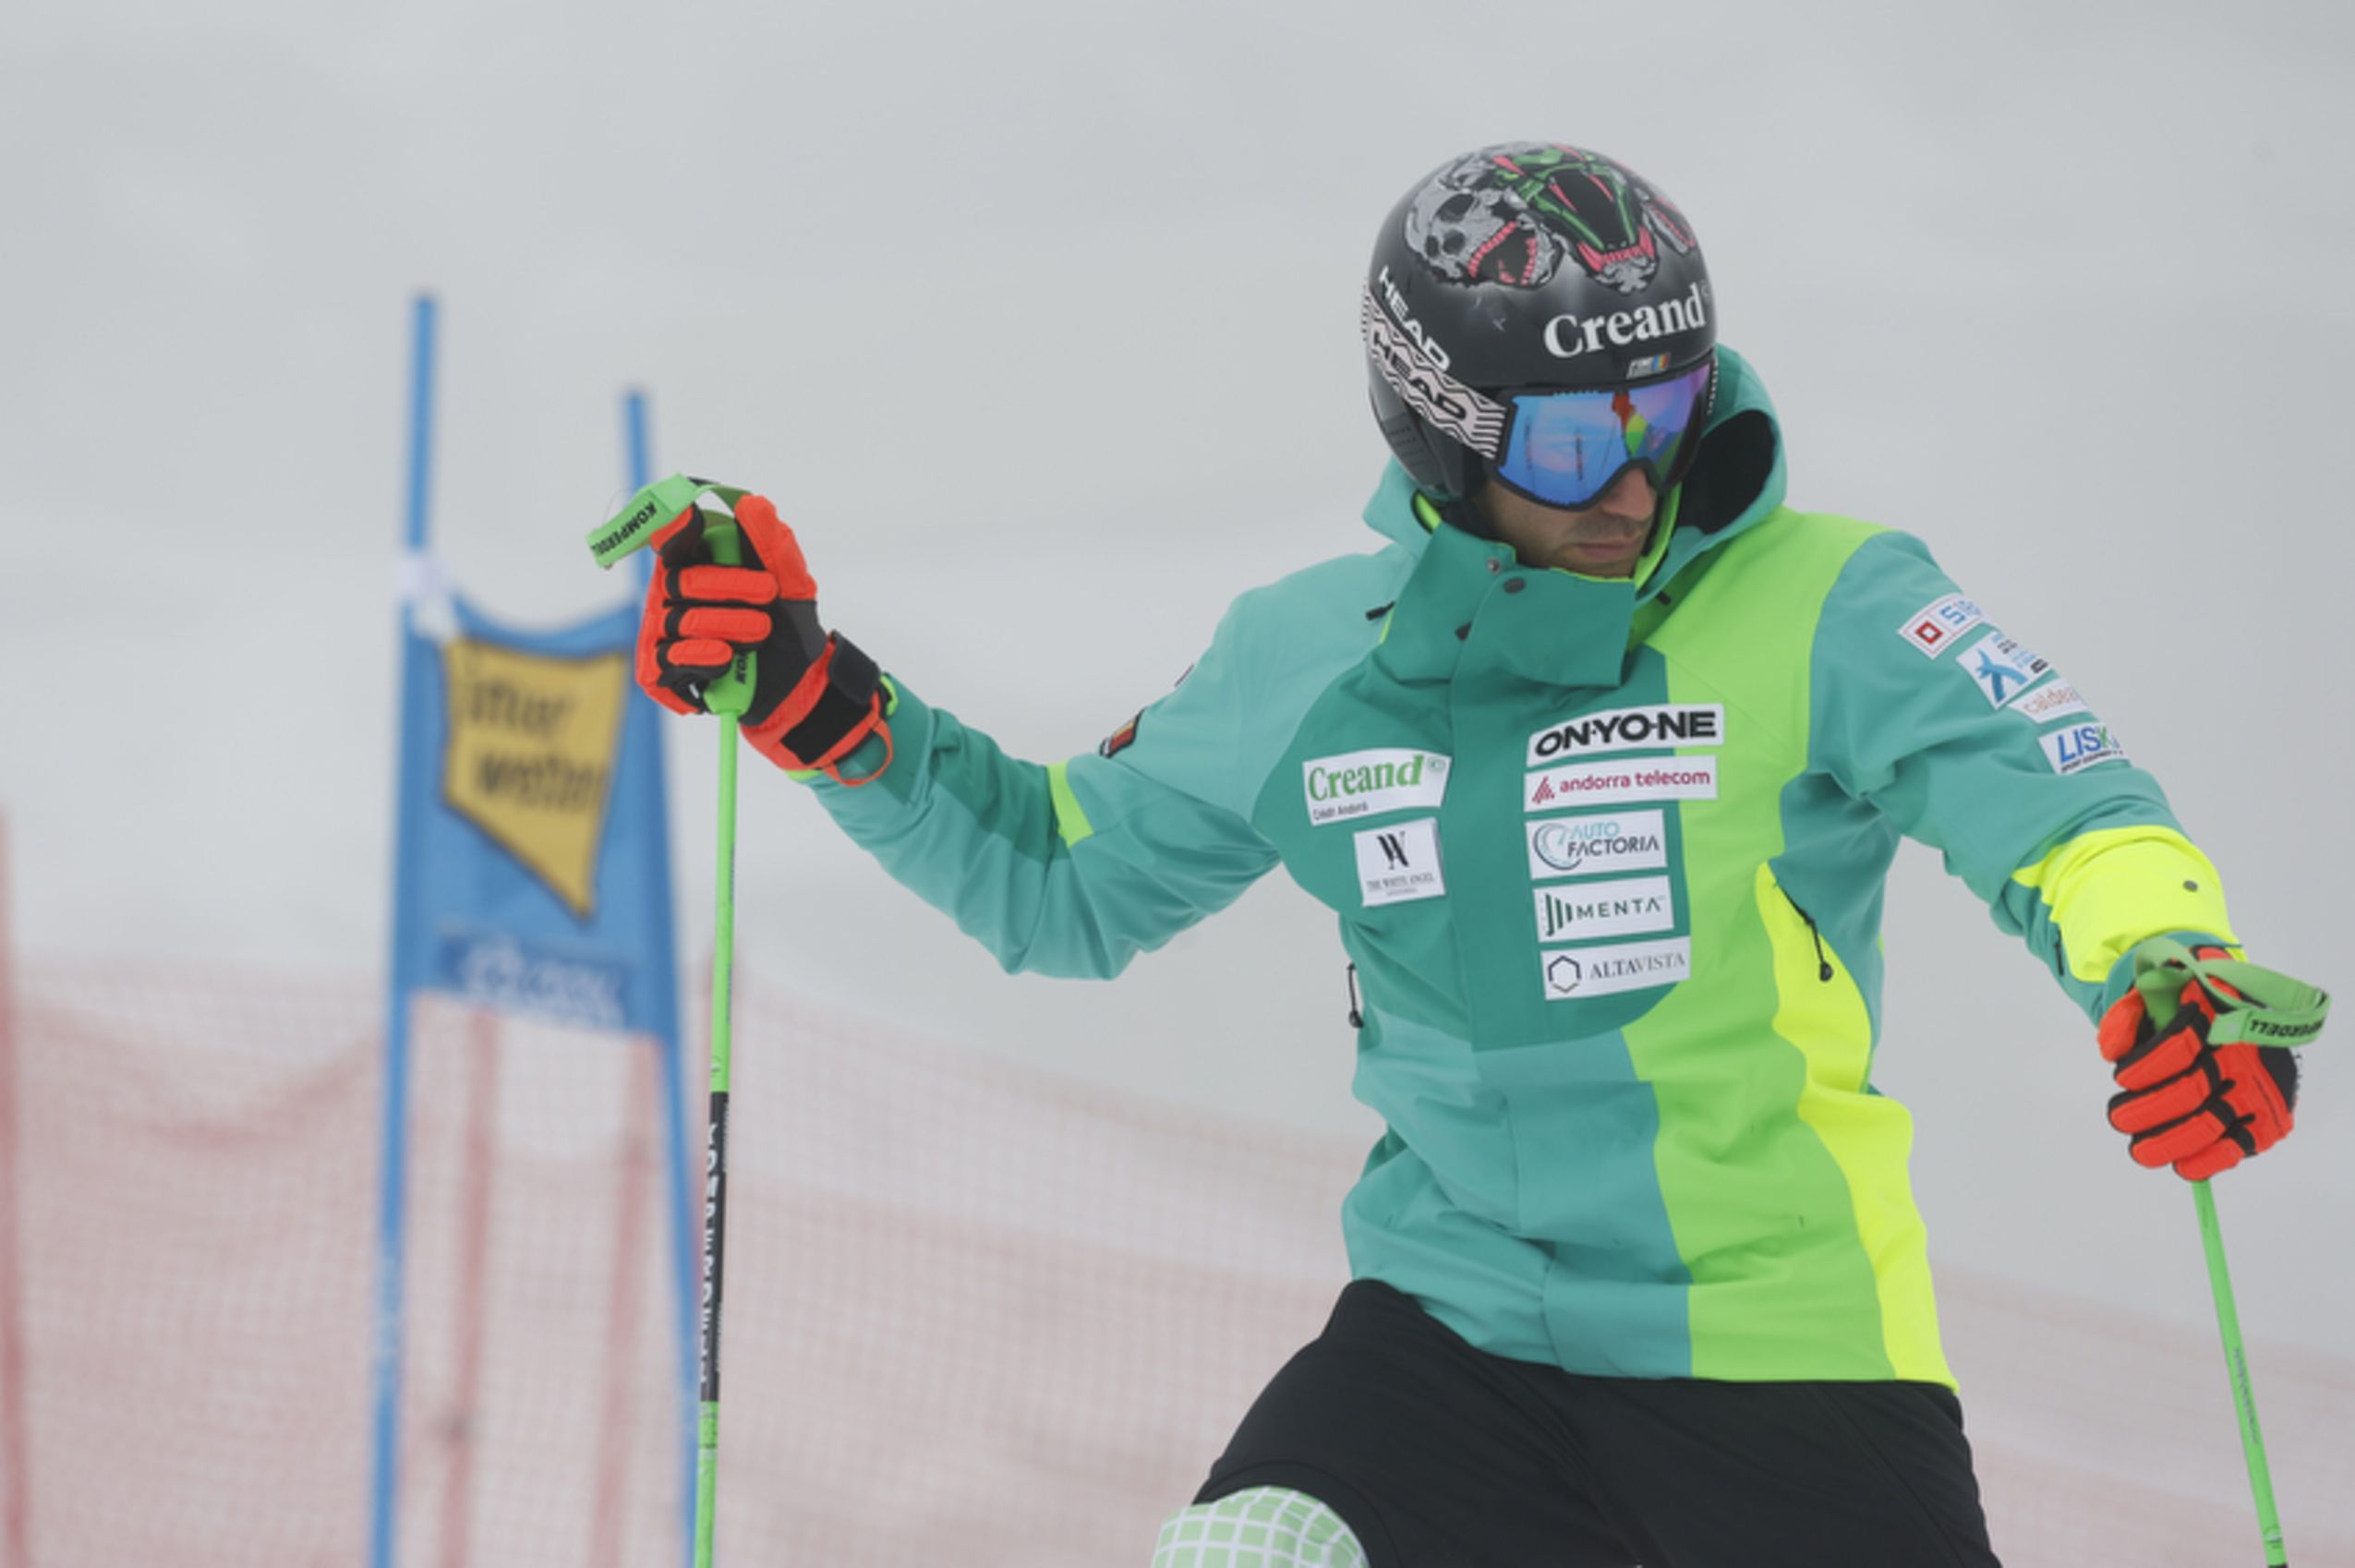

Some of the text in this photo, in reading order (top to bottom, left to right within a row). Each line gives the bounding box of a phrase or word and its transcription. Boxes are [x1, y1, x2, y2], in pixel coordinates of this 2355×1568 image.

[1379, 265, 1451, 371] HEAD
[1543, 282, 1706, 358] Creand
[1373, 331, 1467, 421] HEAD
[1308, 754, 1425, 802] Creand
[1560, 769, 1710, 792] andorra telecom
[1567, 836, 1660, 857] FACTORIA
[1571, 822, 1620, 840] AUTO
[1589, 952, 1685, 980] ALTAVISTA
